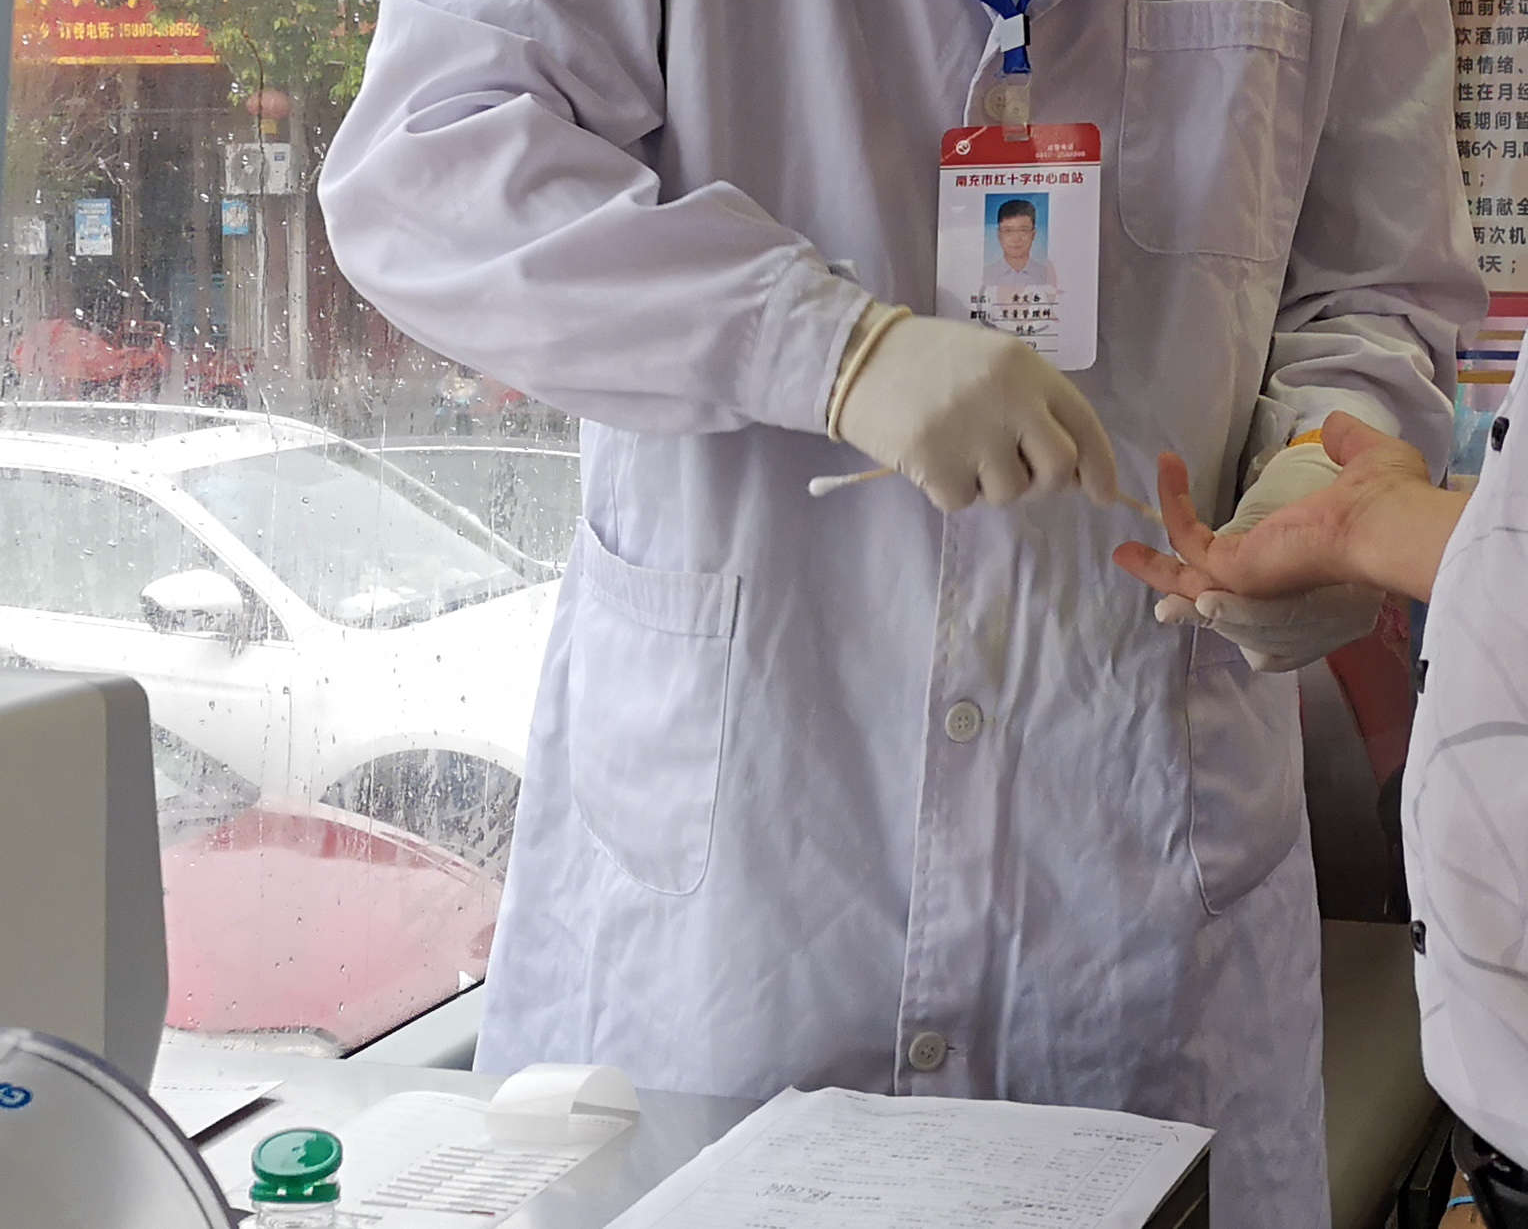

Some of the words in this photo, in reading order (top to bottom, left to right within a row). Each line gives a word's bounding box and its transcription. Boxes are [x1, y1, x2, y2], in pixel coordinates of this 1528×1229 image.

[955, 171, 1085, 187] 南充市红十字中心血站
